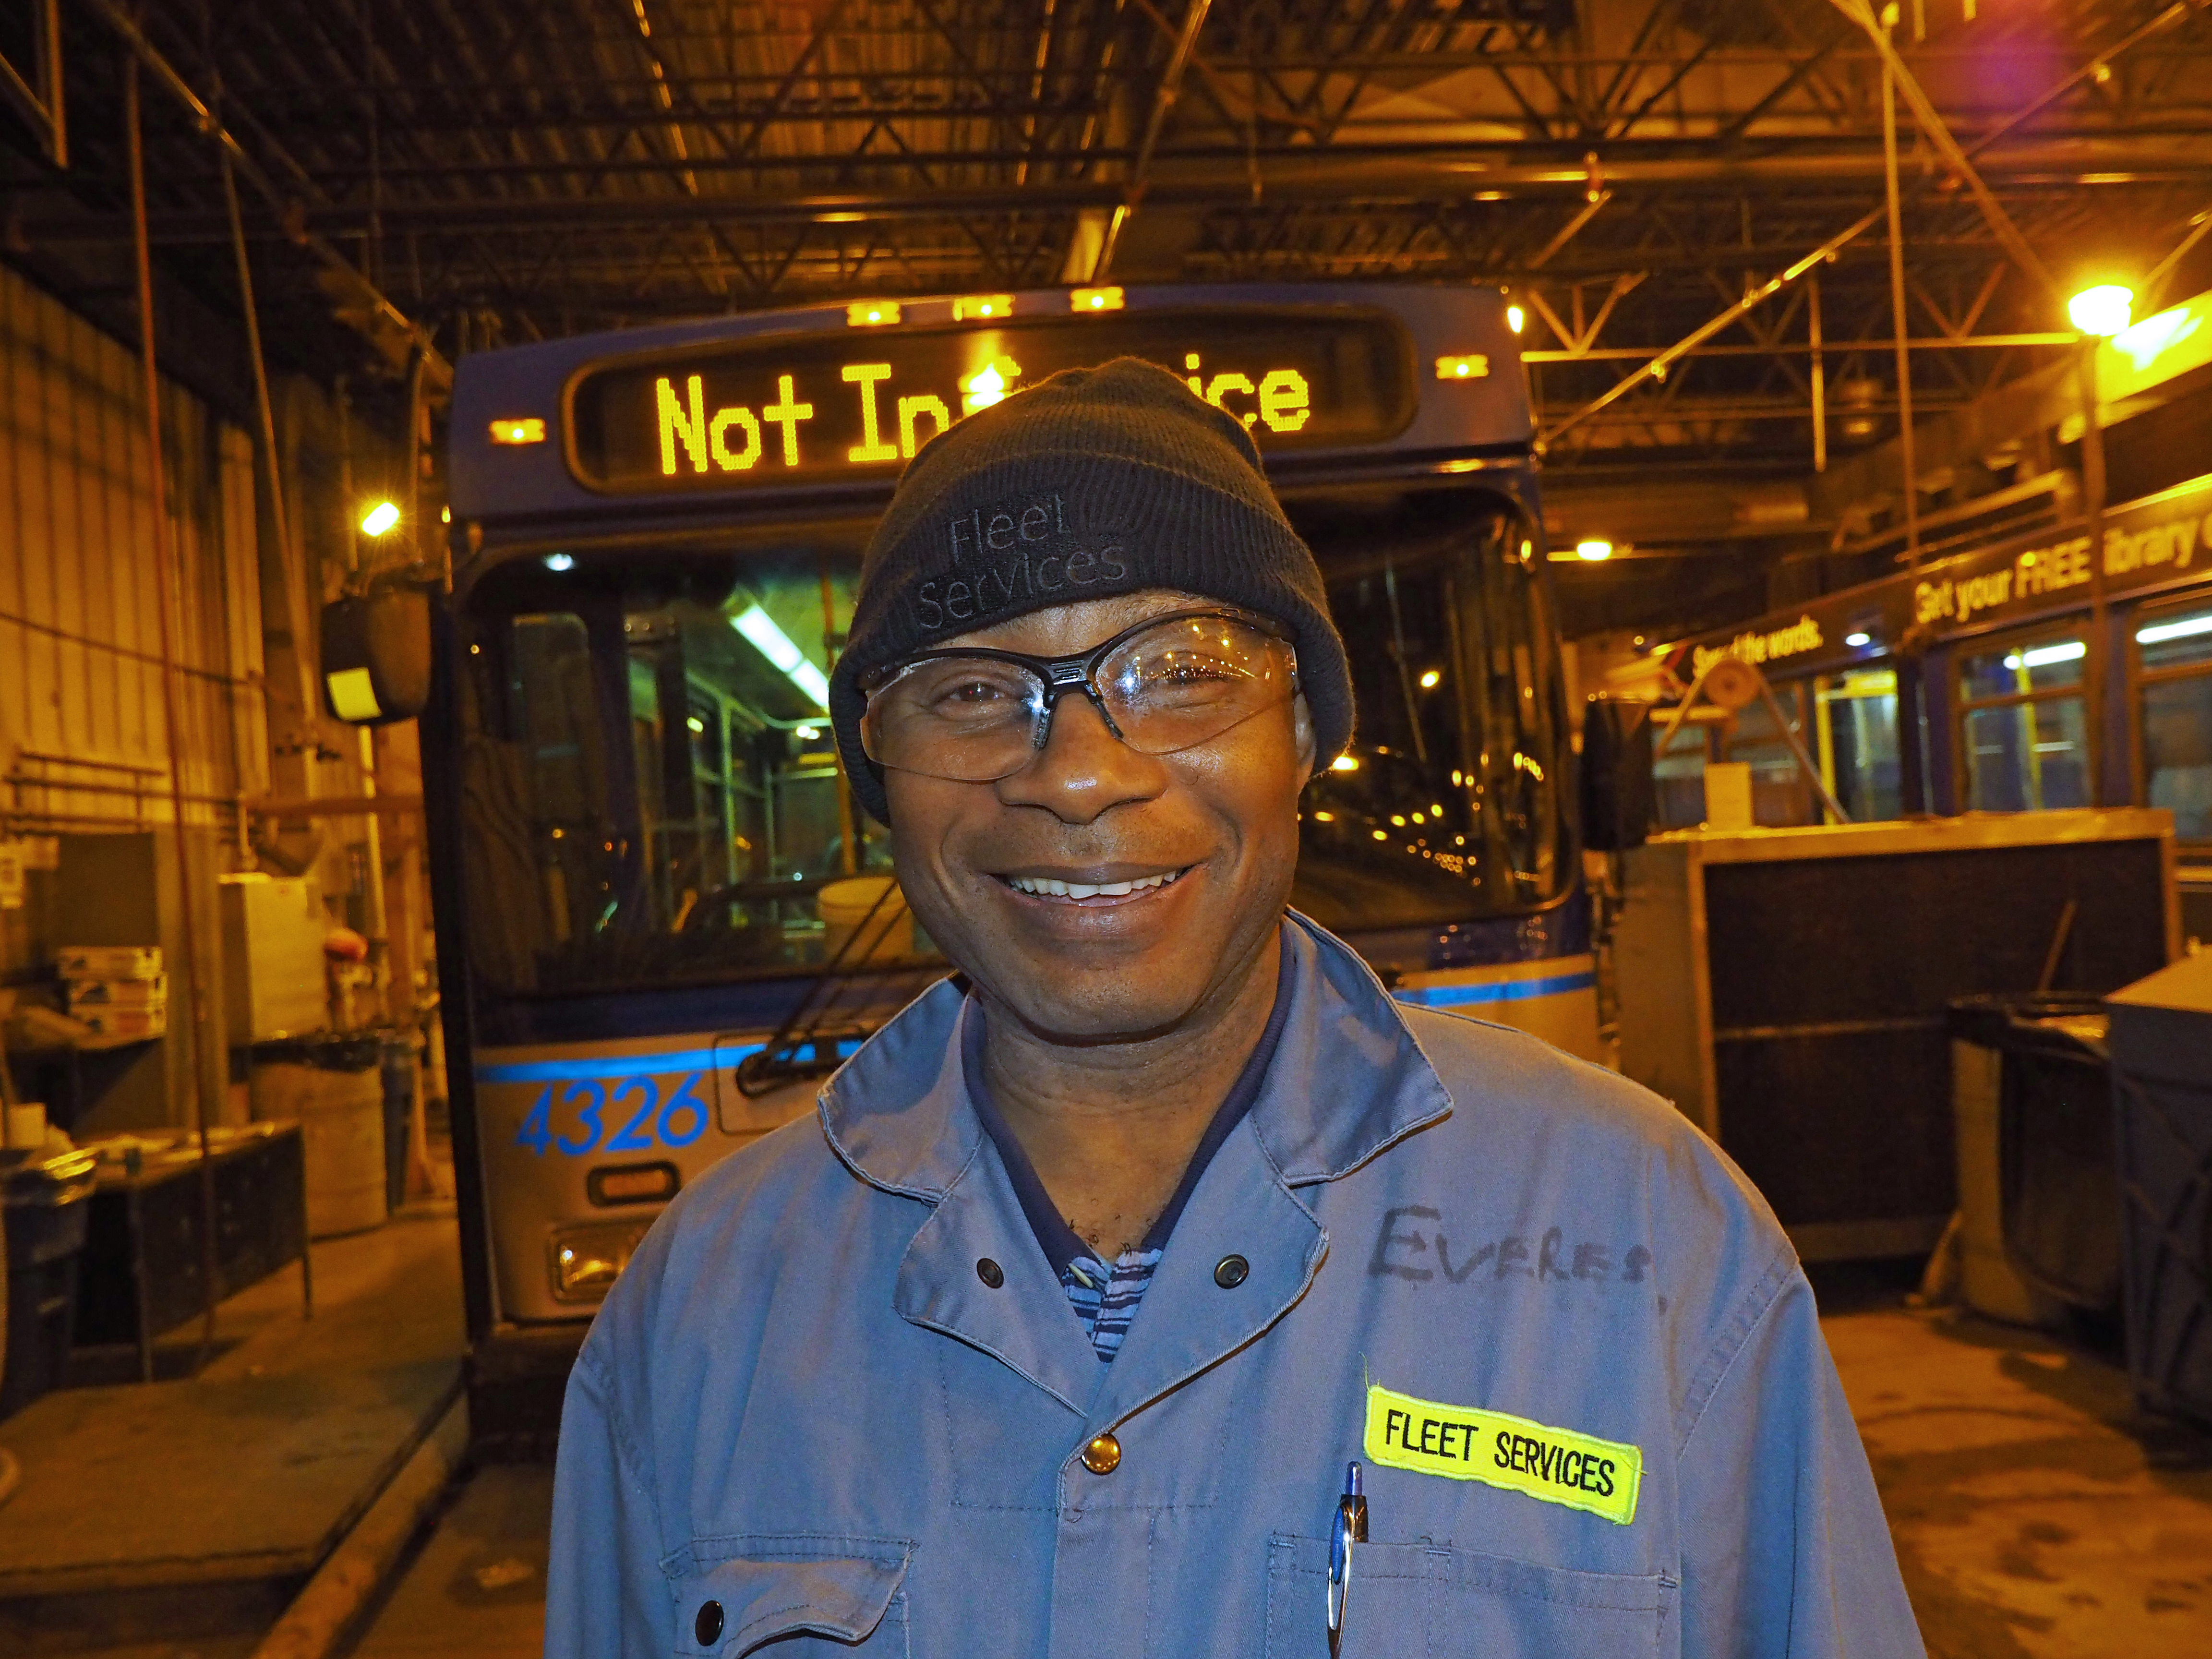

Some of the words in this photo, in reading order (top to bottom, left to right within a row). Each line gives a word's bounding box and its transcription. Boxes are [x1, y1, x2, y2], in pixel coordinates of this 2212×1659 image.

[656, 375, 813, 474] Not
[842, 363, 950, 462] In
[918, 544, 1126, 629] Services
[1955, 567, 2014, 623] your
[2015, 535, 2092, 599] FREE
[2103, 519, 2200, 576] ibrary
[515, 1072, 709, 1157] 4326
[1384, 1409, 1479, 1462] FLEET
[1494, 1431, 1615, 1497] SERVICES
